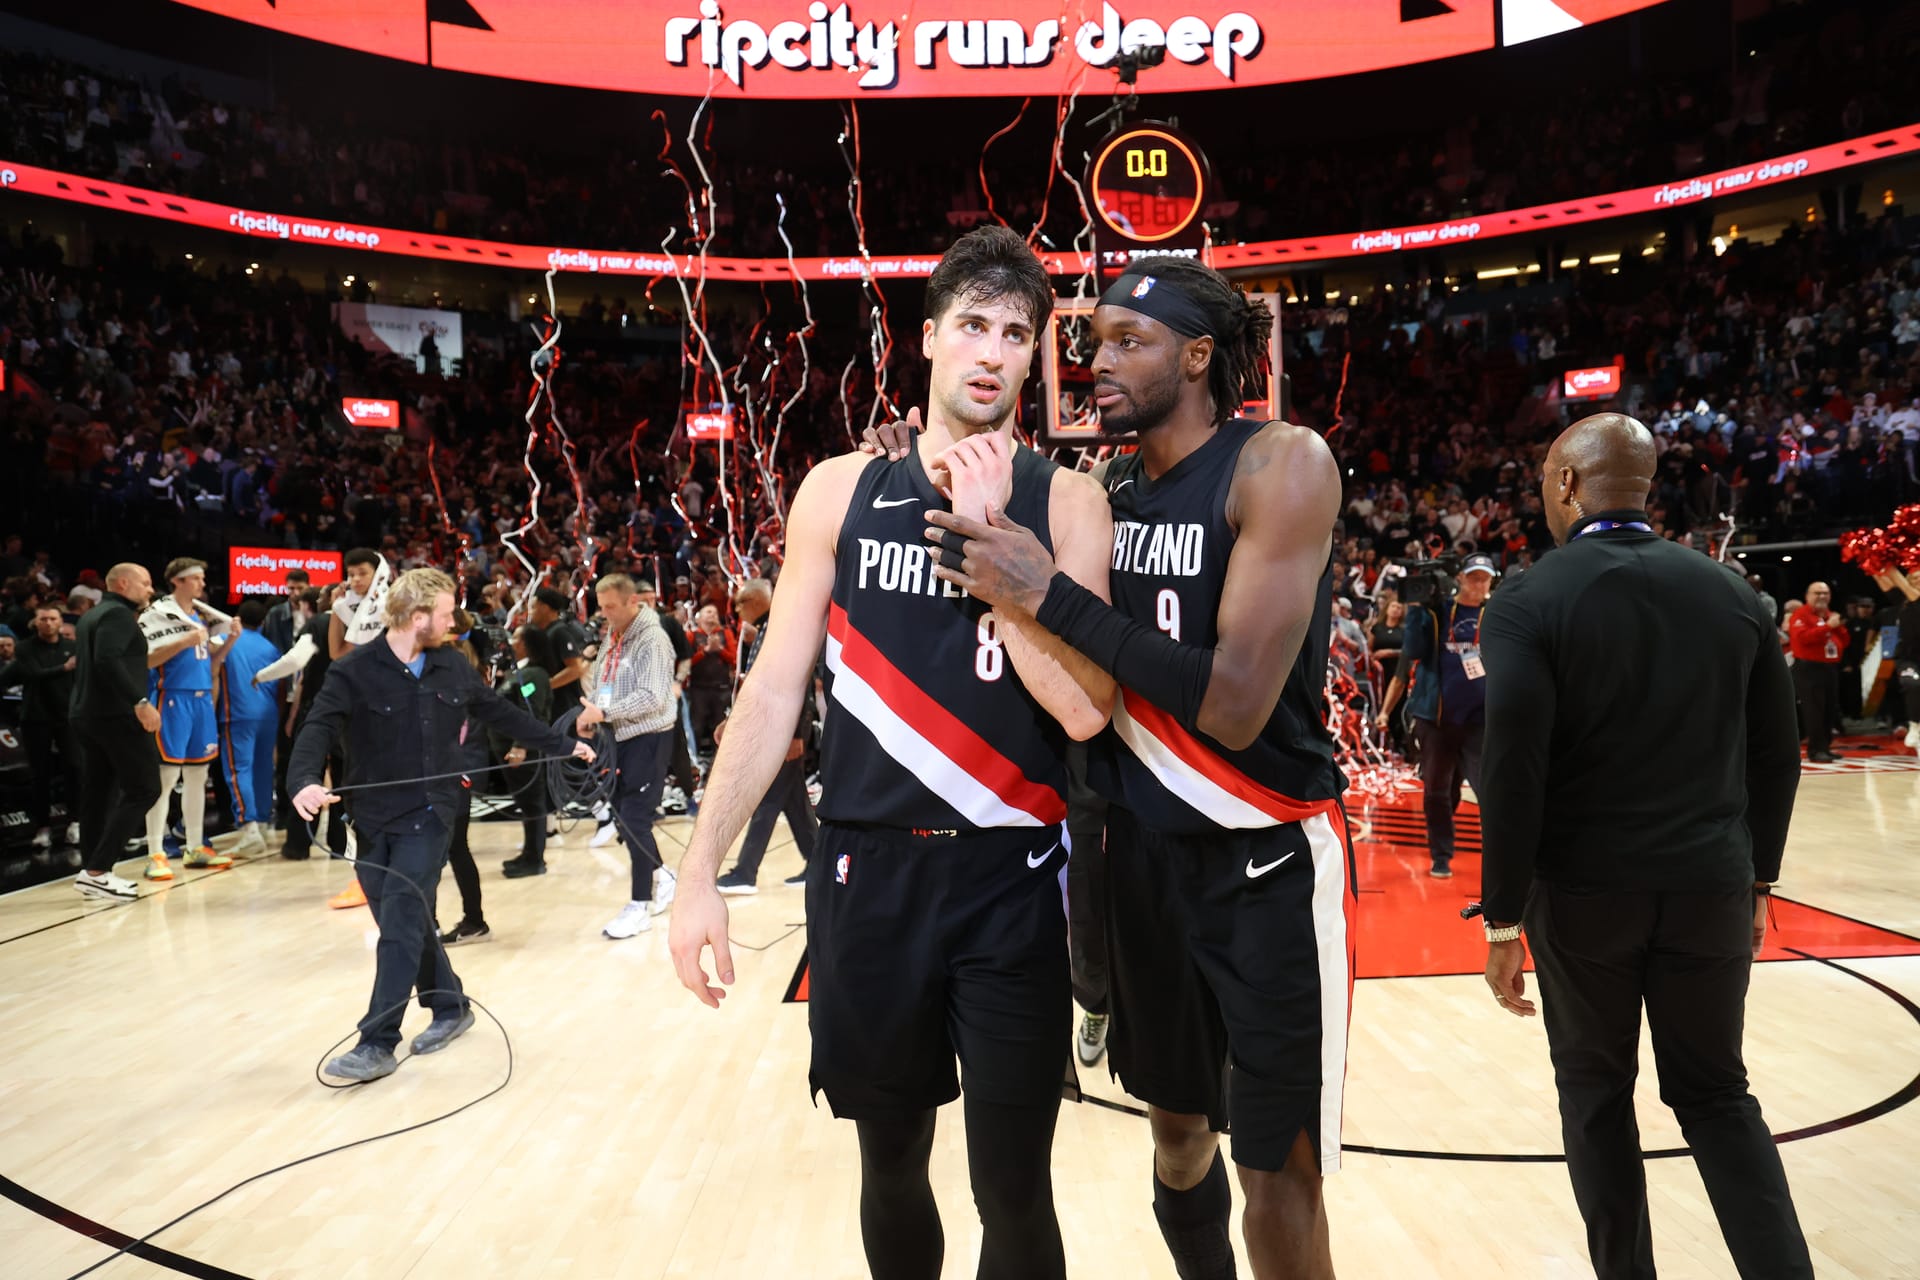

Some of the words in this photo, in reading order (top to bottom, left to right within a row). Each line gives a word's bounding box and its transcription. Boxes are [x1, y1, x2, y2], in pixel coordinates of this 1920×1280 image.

[665, 0, 899, 90] ripcity
[914, 20, 1060, 68] runs
[1074, 0, 1264, 82] deep
[1126, 149, 1167, 177] 0.0
[1654, 180, 1713, 204] ripcity
[1715, 170, 1754, 190] runs
[1756, 158, 1808, 180] deep
[229, 210, 290, 239] ripcity
[292, 223, 331, 239] runs
[333, 225, 380, 249] deep
[1352, 233, 1402, 251] ripcity
[1403, 229, 1437, 244] runs
[1438, 223, 1480, 239] deep
[600, 256, 632, 269] runs
[634, 256, 675, 274] deep
[870, 261, 901, 273] runs
[235, 553, 277, 571] ripcity
[278, 558, 305, 569] runs
[305, 558, 336, 572] deep
[1157, 588, 1180, 643] 9
[975, 611, 1003, 683] 8
